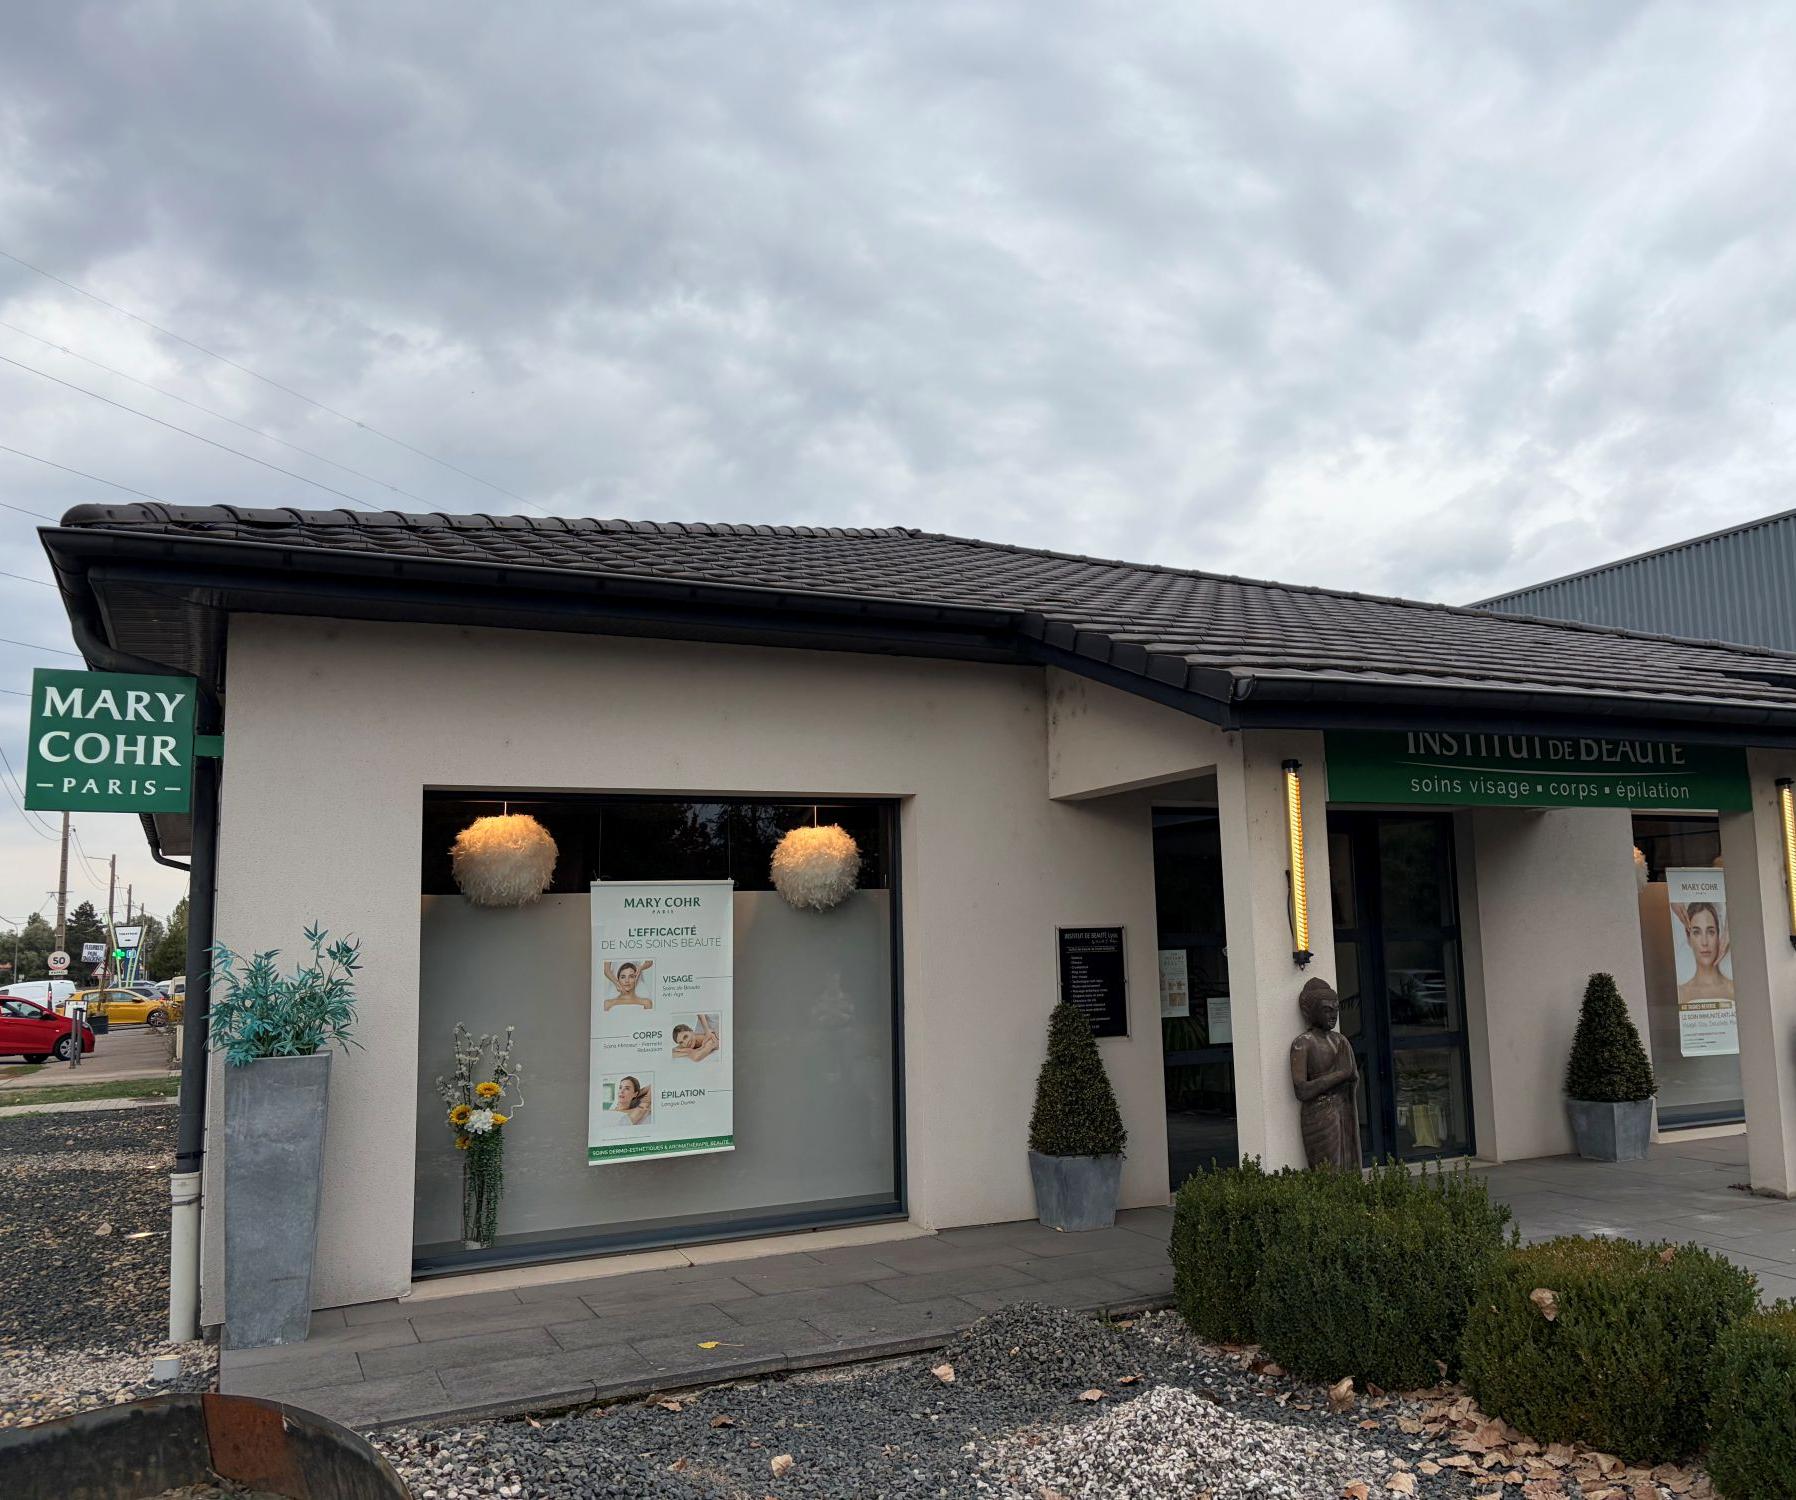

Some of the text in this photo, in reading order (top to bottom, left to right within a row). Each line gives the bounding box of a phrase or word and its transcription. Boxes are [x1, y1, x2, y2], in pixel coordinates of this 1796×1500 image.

[41, 686, 186, 723] MARY
[38, 730, 182, 767] COHR
[1548, 739, 1575, 760] DE
[62, 777, 157, 796] PARIS
[1411, 775, 1690, 801] soins visage corps épilation
[1681, 882, 1718, 891] MARY COHR
[624, 896, 701, 908] MARY COHR
[628, 925, 697, 937] L'EFFICACITÉ
[601, 940, 616, 950] DE
[619, 939, 643, 949] NOS
[645, 938, 679, 949] SOINS
[52, 956, 66, 965] 50
[662, 974, 693, 983] VISAGE
[632, 1030, 663, 1040] CORPS
[661, 1088, 706, 1099] ÉPILATION
